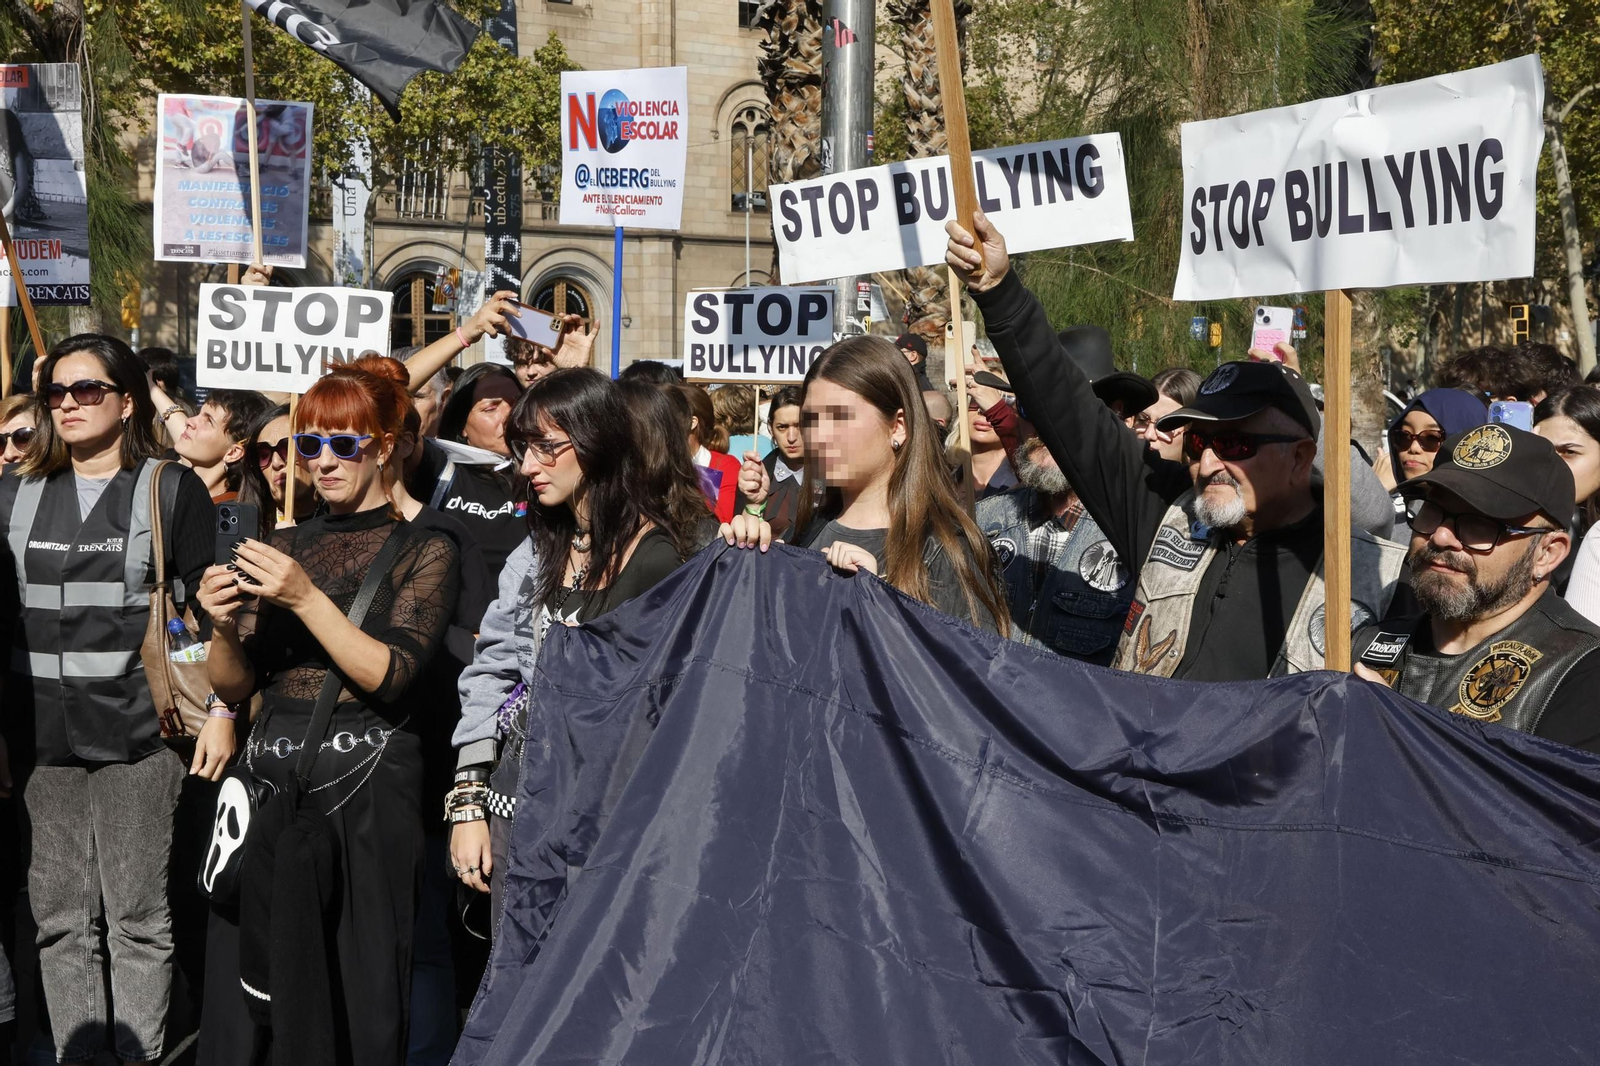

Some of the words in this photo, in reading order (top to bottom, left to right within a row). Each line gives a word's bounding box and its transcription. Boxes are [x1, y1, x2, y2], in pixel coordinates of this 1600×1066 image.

[615, 100, 679, 117] VIOLENCIA
[621, 121, 678, 140] ESCOLAR
[650, 168, 660, 177] DEL
[177, 180, 290, 197] MANIFESTCIÓ
[650, 179, 676, 188] BULLYING
[583, 194, 601, 203] ANTE
[780, 178, 879, 242] STOP
[893, 143, 1105, 226] BULYING
[1190, 186, 1276, 256] STOP
[1284, 138, 1504, 242] BULLYING
[188, 198, 250, 211] CONTRA
[184, 229, 196, 241] A
[199, 230, 224, 242] LES
[225, 231, 290, 247] ESCLES
[27, 285, 90, 300] RENCATS
[208, 286, 384, 338] STOP
[691, 293, 828, 336] STOP
[206, 339, 381, 375] BULLYIN
